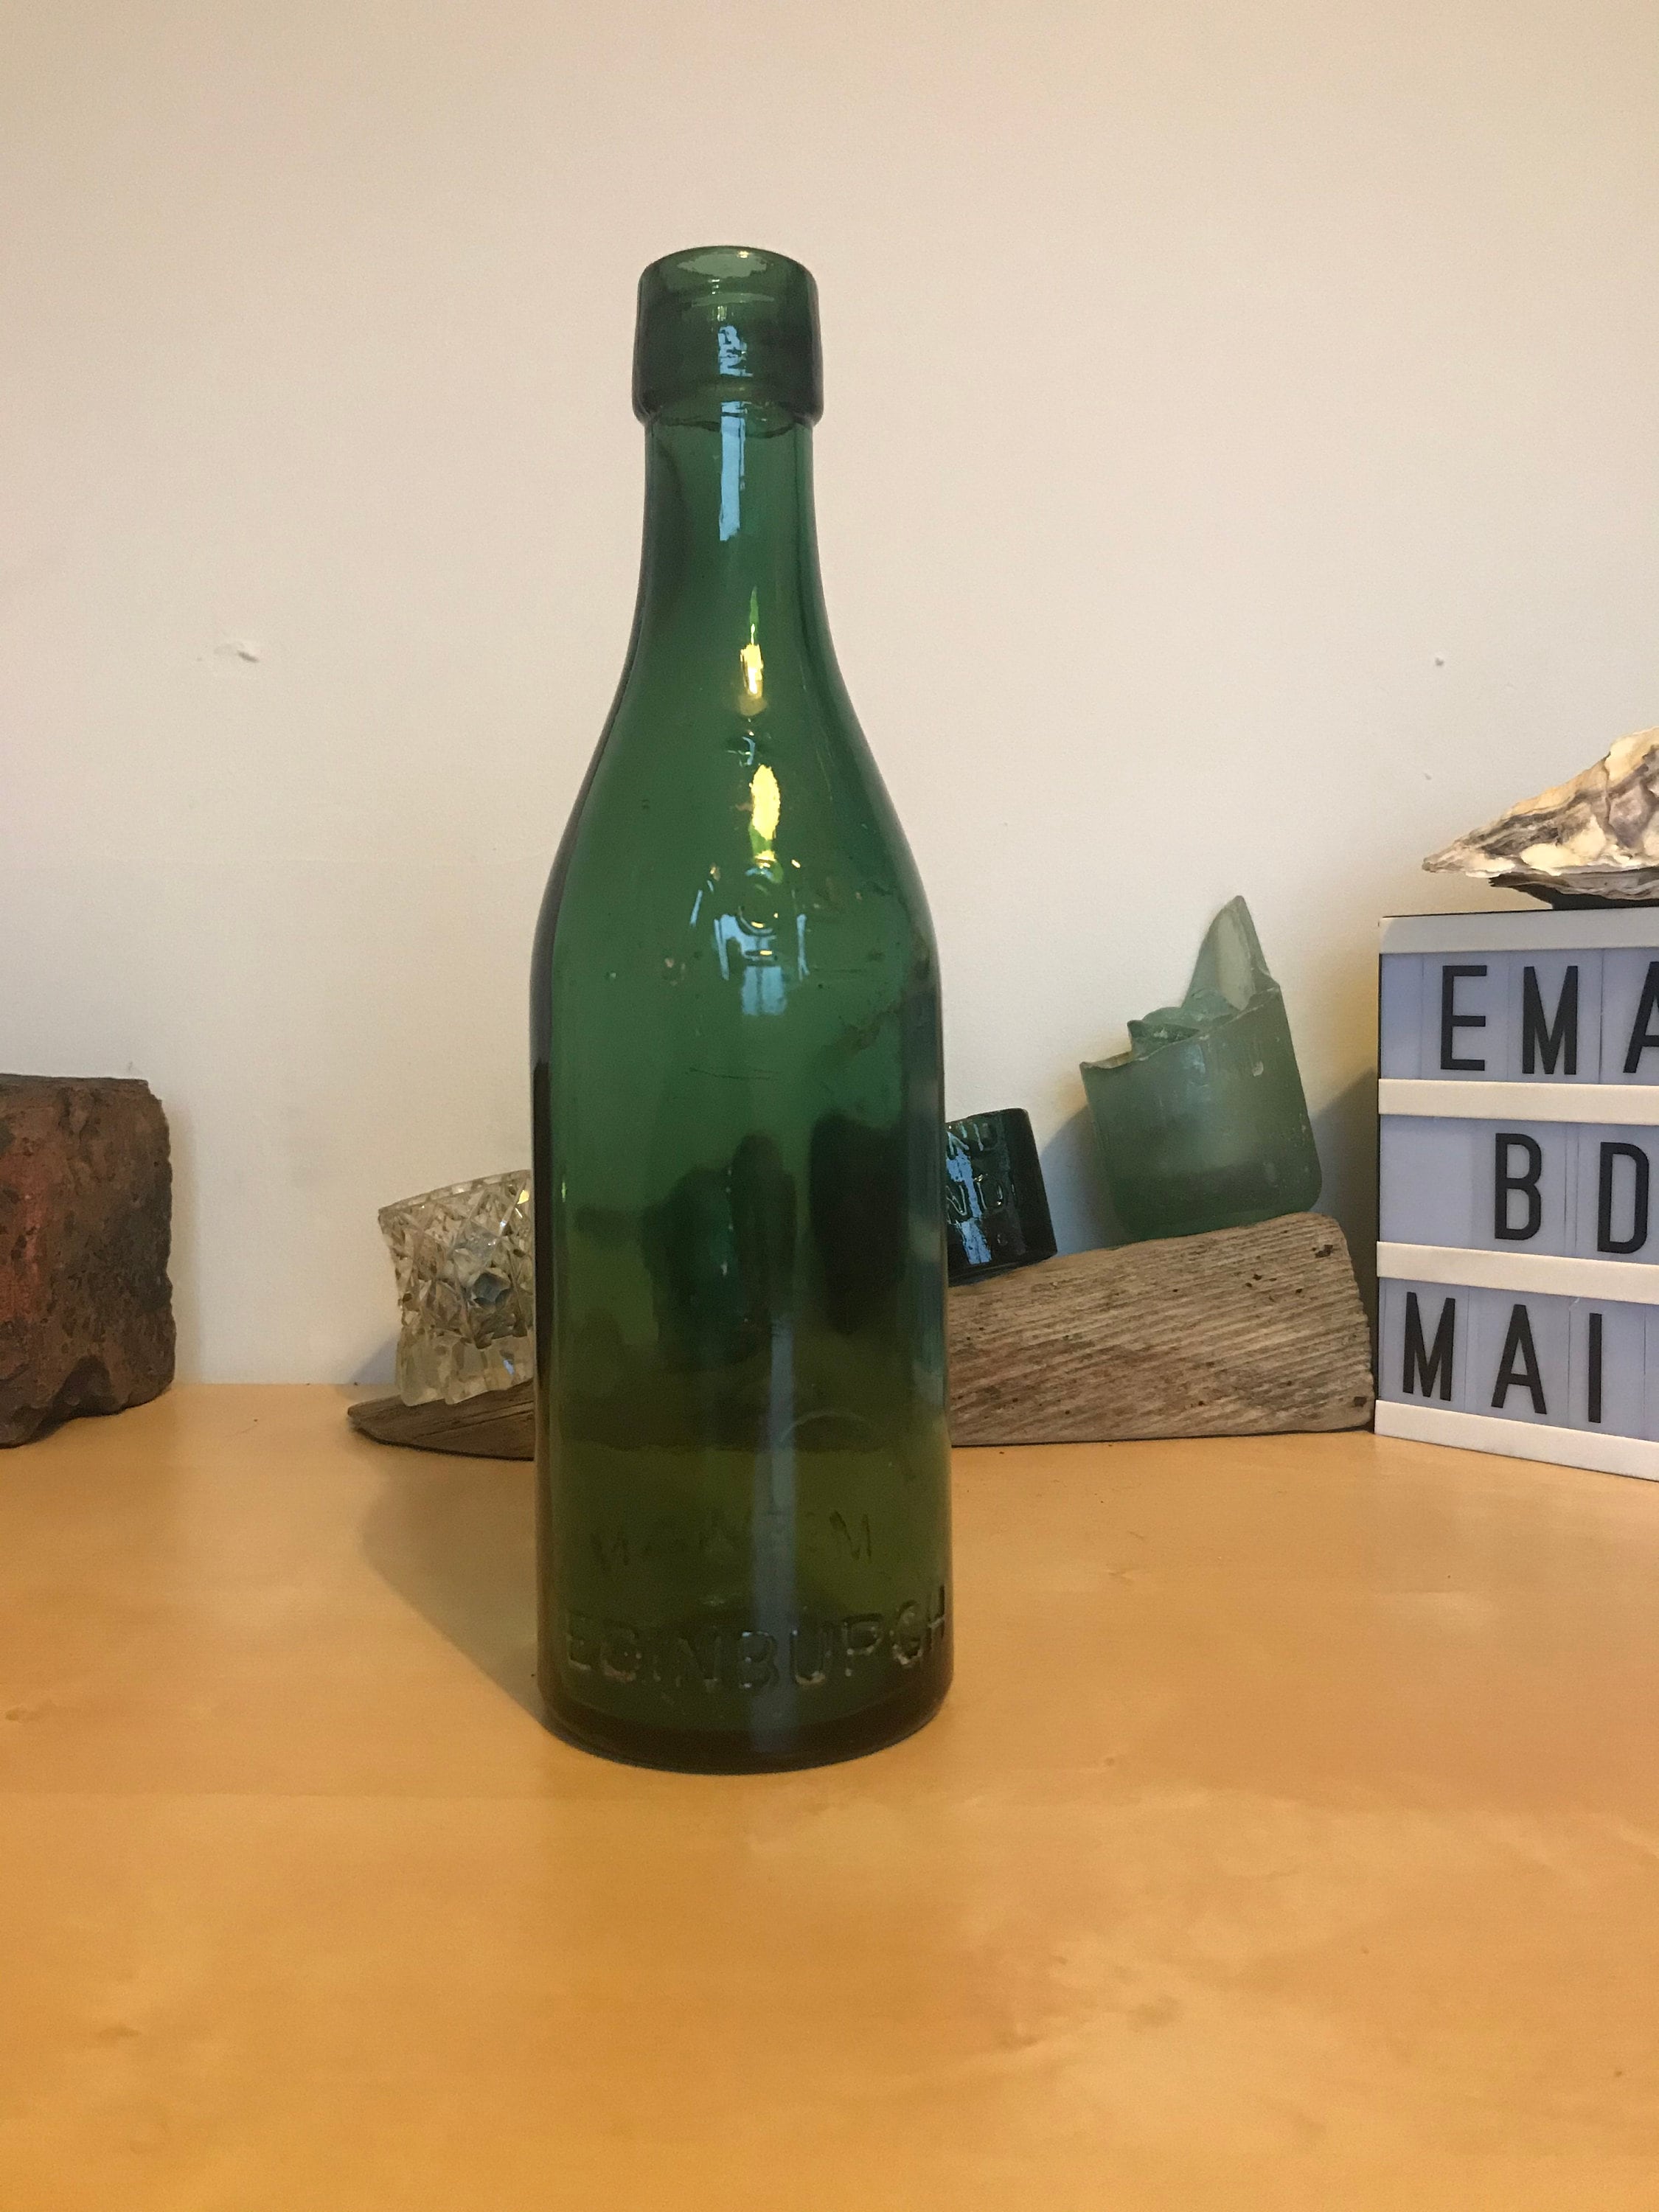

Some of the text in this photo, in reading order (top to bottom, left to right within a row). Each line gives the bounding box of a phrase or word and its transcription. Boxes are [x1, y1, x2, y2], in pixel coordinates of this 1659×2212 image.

[1440, 961, 1659, 1075] EMA
[1495, 1133, 1649, 1254] BD
[1402, 1292, 1602, 1424] MAI
